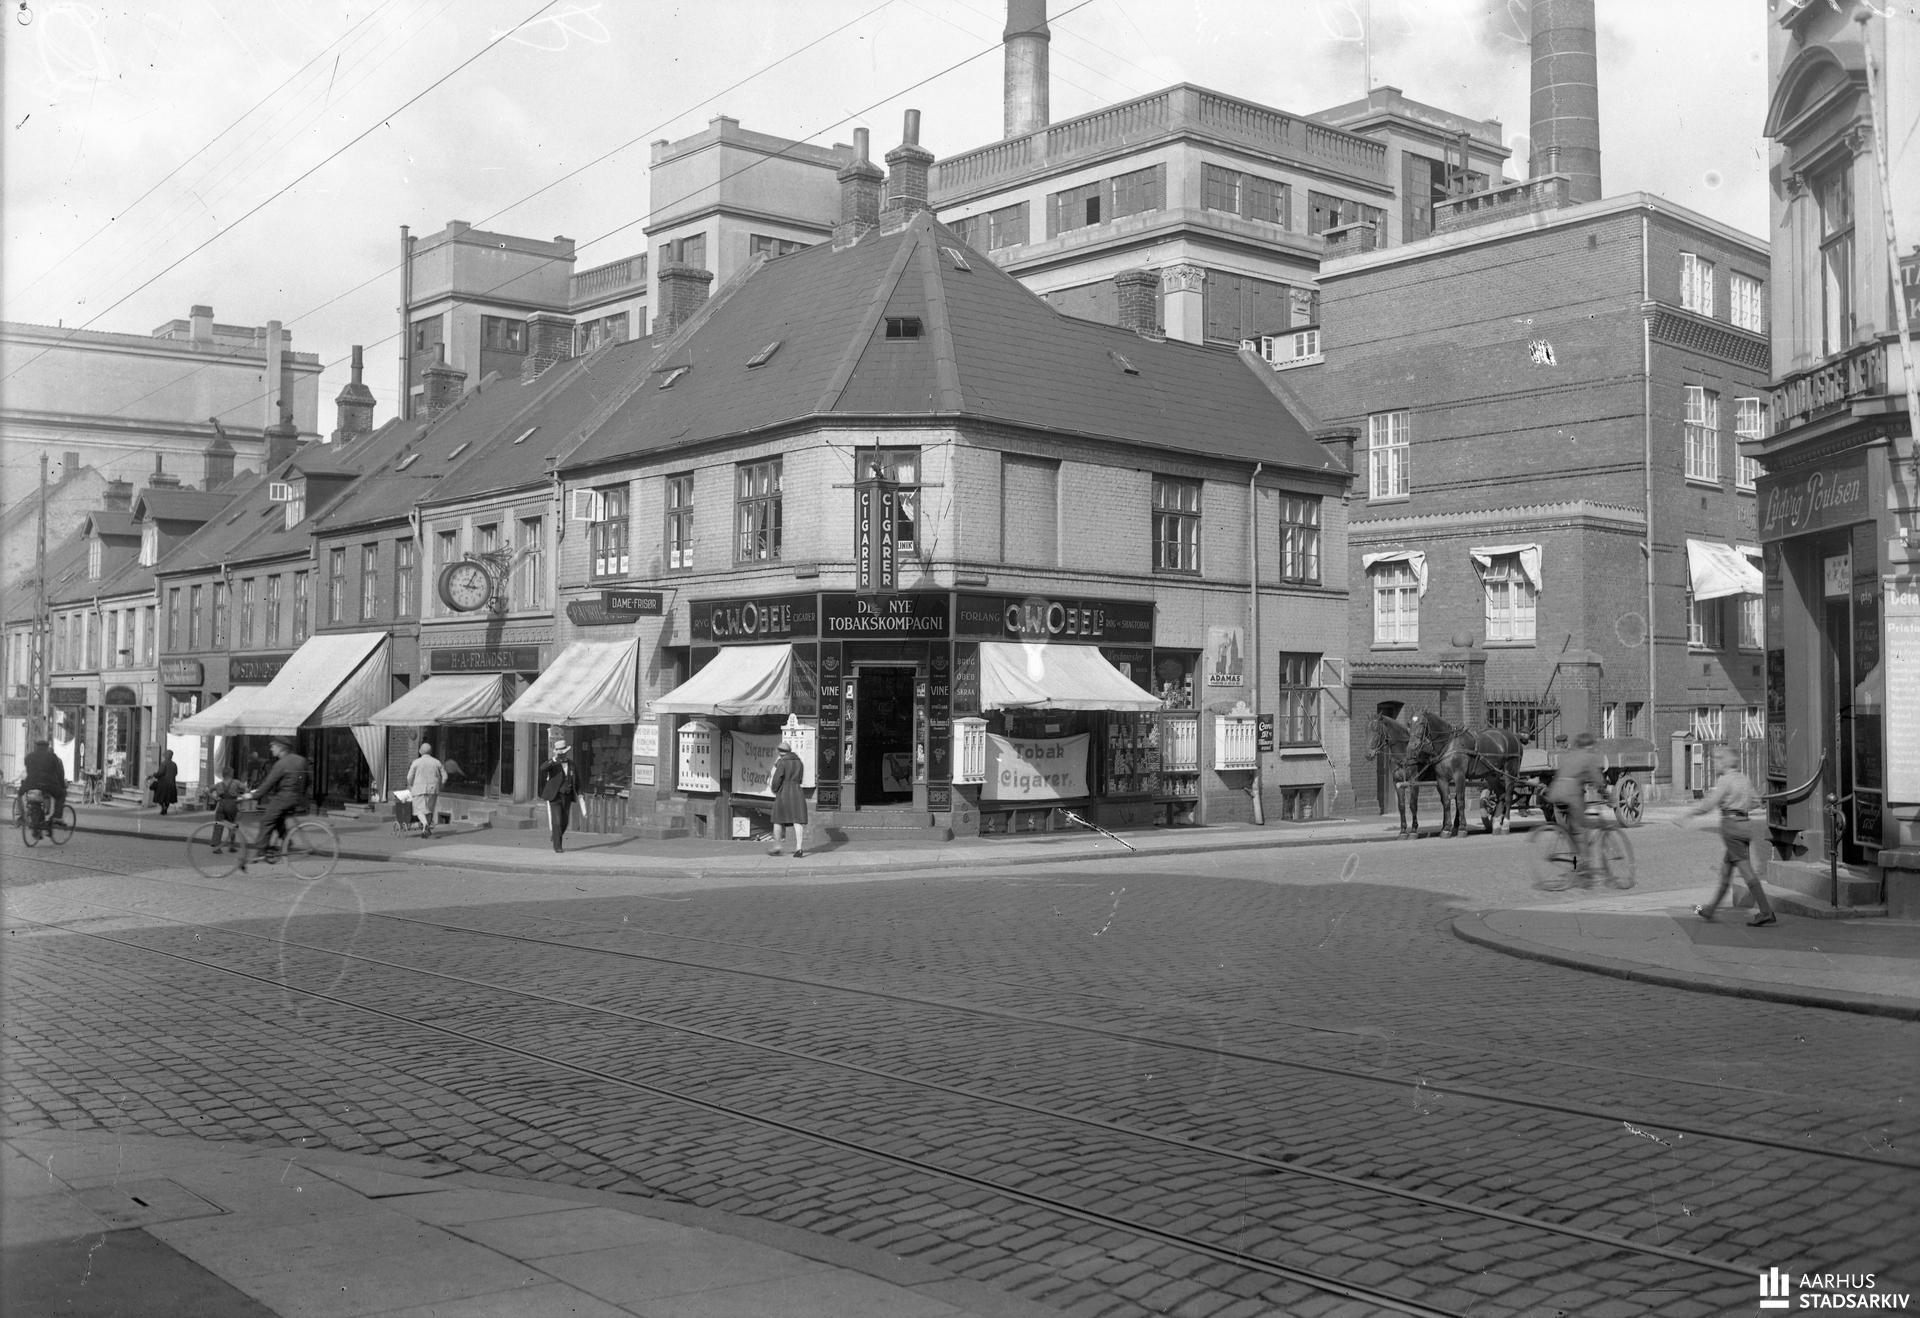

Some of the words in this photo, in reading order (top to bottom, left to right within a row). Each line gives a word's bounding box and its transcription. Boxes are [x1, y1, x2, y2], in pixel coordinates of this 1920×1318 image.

[1762, 486, 1803, 532] Ludvig
[1802, 471, 1860, 528] Poulsen
[861, 493, 869, 586] CIGARER
[882, 493, 892, 586] CIGARER
[889, 600, 913, 614] NYE
[828, 616, 944, 631] TOBAKSKOMPAGNI
[960, 611, 1000, 622] FORLANG
[821, 686, 840, 696] VINE
[930, 685, 949, 696] VINE
[1013, 743, 1065, 760] Tobak
